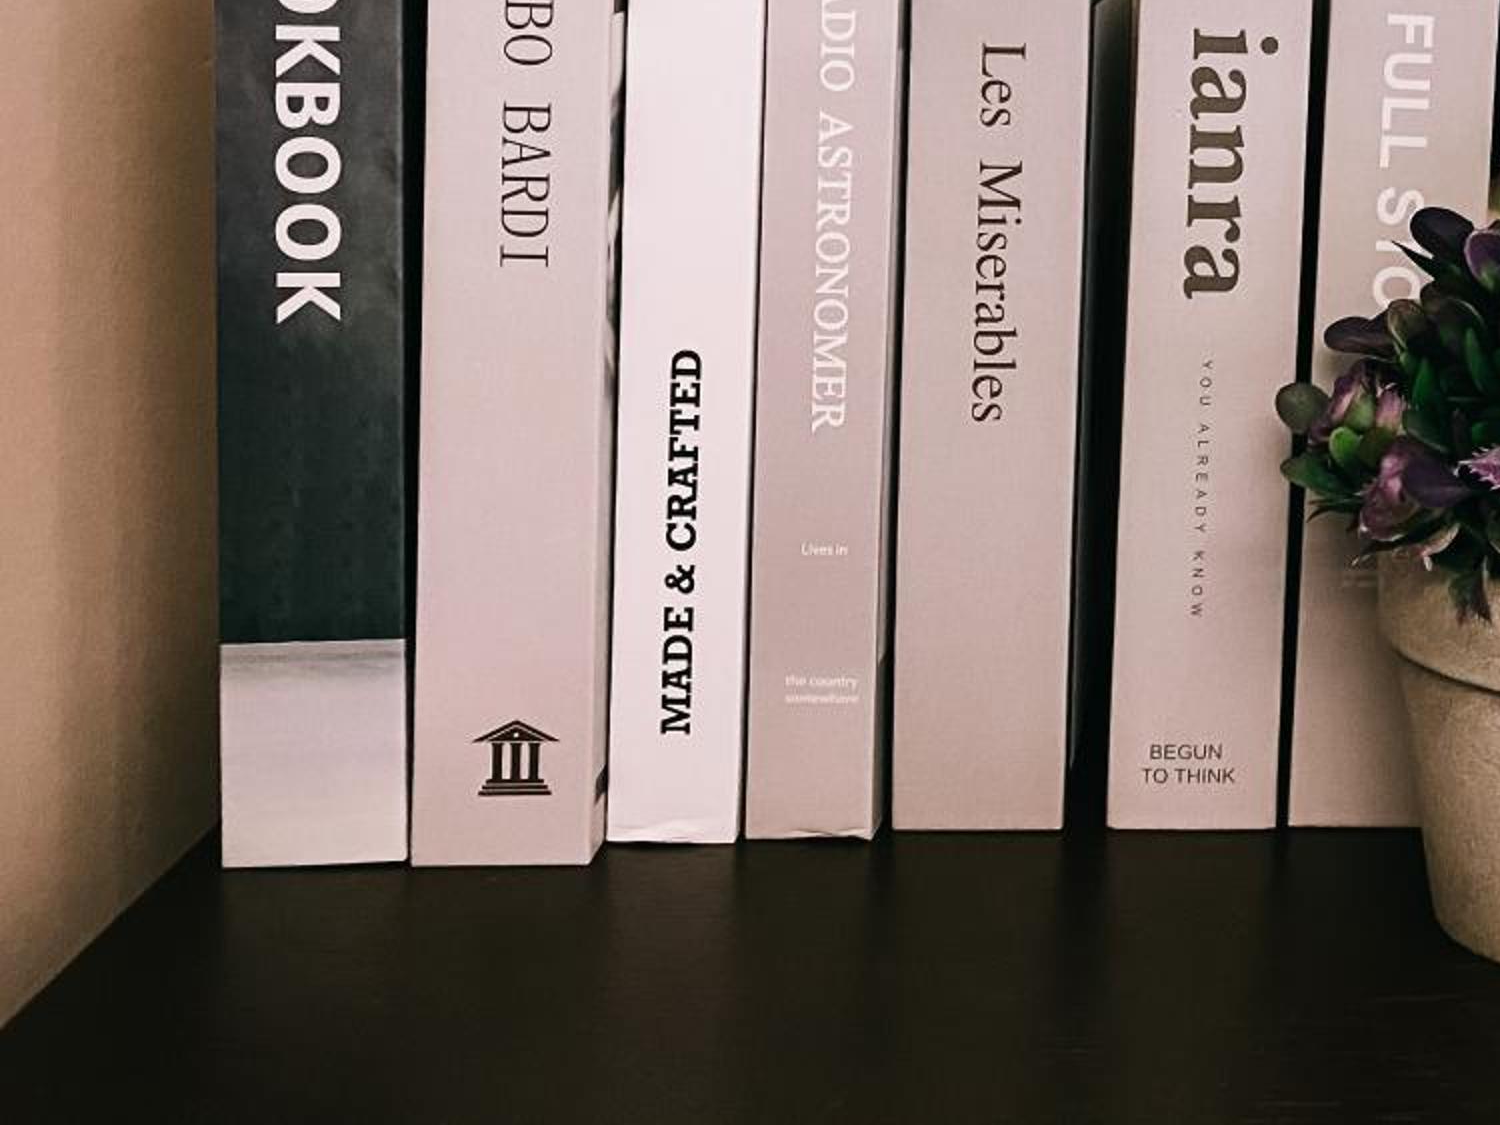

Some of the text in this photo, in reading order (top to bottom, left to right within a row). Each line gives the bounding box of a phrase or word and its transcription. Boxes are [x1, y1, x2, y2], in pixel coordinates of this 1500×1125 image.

[499, 101, 553, 268] BARDI
[1182, 27, 1280, 300] ianra
[1379, 13, 1436, 169] FULL
[810, 110, 854, 434] ASTRONOMER
[970, 42, 1027, 422] Les Miserables
[660, 349, 703, 736] MADE & CRAFTED
[835, 543, 849, 556] in
[1190, 360, 1214, 618] YOU ALREADY KNOW
[1142, 767, 1235, 785] TO THINK
[1148, 743, 1223, 761] BEGUN
